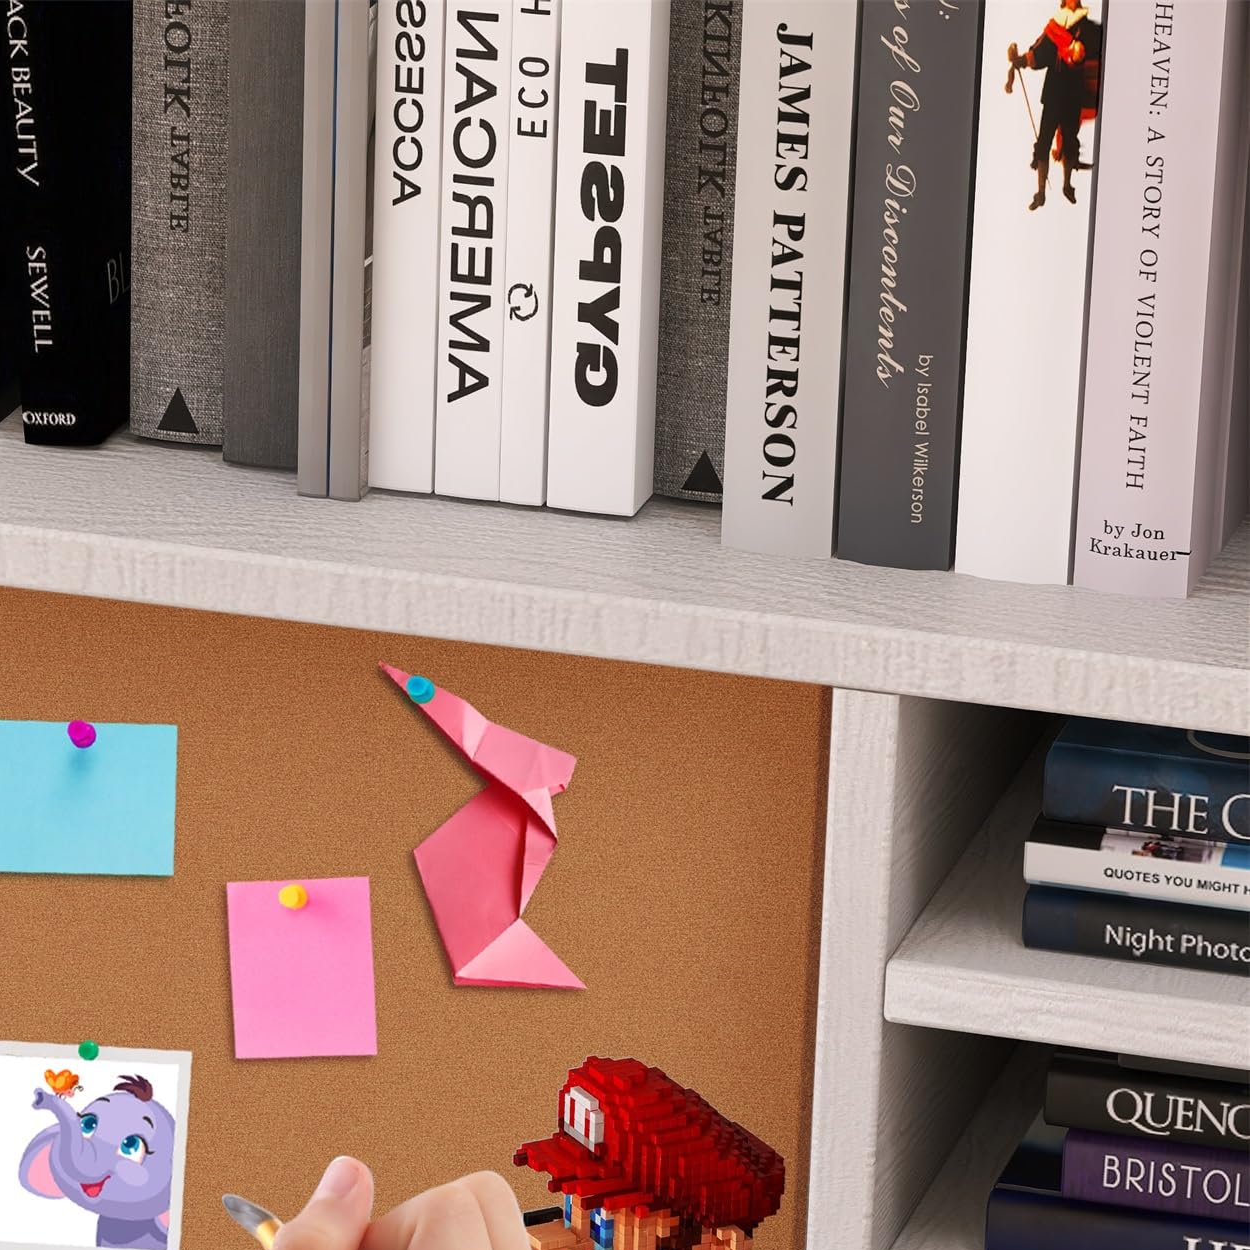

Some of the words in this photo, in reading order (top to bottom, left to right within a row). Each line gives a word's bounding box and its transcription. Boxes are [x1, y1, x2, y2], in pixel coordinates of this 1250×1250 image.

[880, 26, 921, 72] of
[1149, 2, 1174, 115] HEAVEN:
[11, 67, 40, 187] BEAUTY
[774, 23, 814, 192] JAMES
[888, 80, 920, 154] Our
[1147, 126, 1166, 144] A
[1141, 155, 1165, 239] STORY
[27, 245, 53, 353] SEWELL
[875, 163, 916, 389] Discontents
[1139, 249, 1159, 283] OF
[761, 210, 806, 507] PATTERSON
[916, 354, 934, 378] by
[1131, 295, 1156, 405] VIOLENT
[22, 411, 76, 427] OXFORD
[914, 382, 932, 437] Isabel
[910, 442, 930, 524] Wilkerson
[1125, 414, 1148, 490] FAITH
[1103, 520, 1125, 539] by
[1131, 523, 1165, 540] Jon
[1112, 784, 1209, 835] THE
[1103, 867, 1160, 884] QUOTES
[1164, 875, 1193, 888] YOU
[1196, 879, 1240, 894] MIGHT
[1105, 924, 1175, 957] Night
